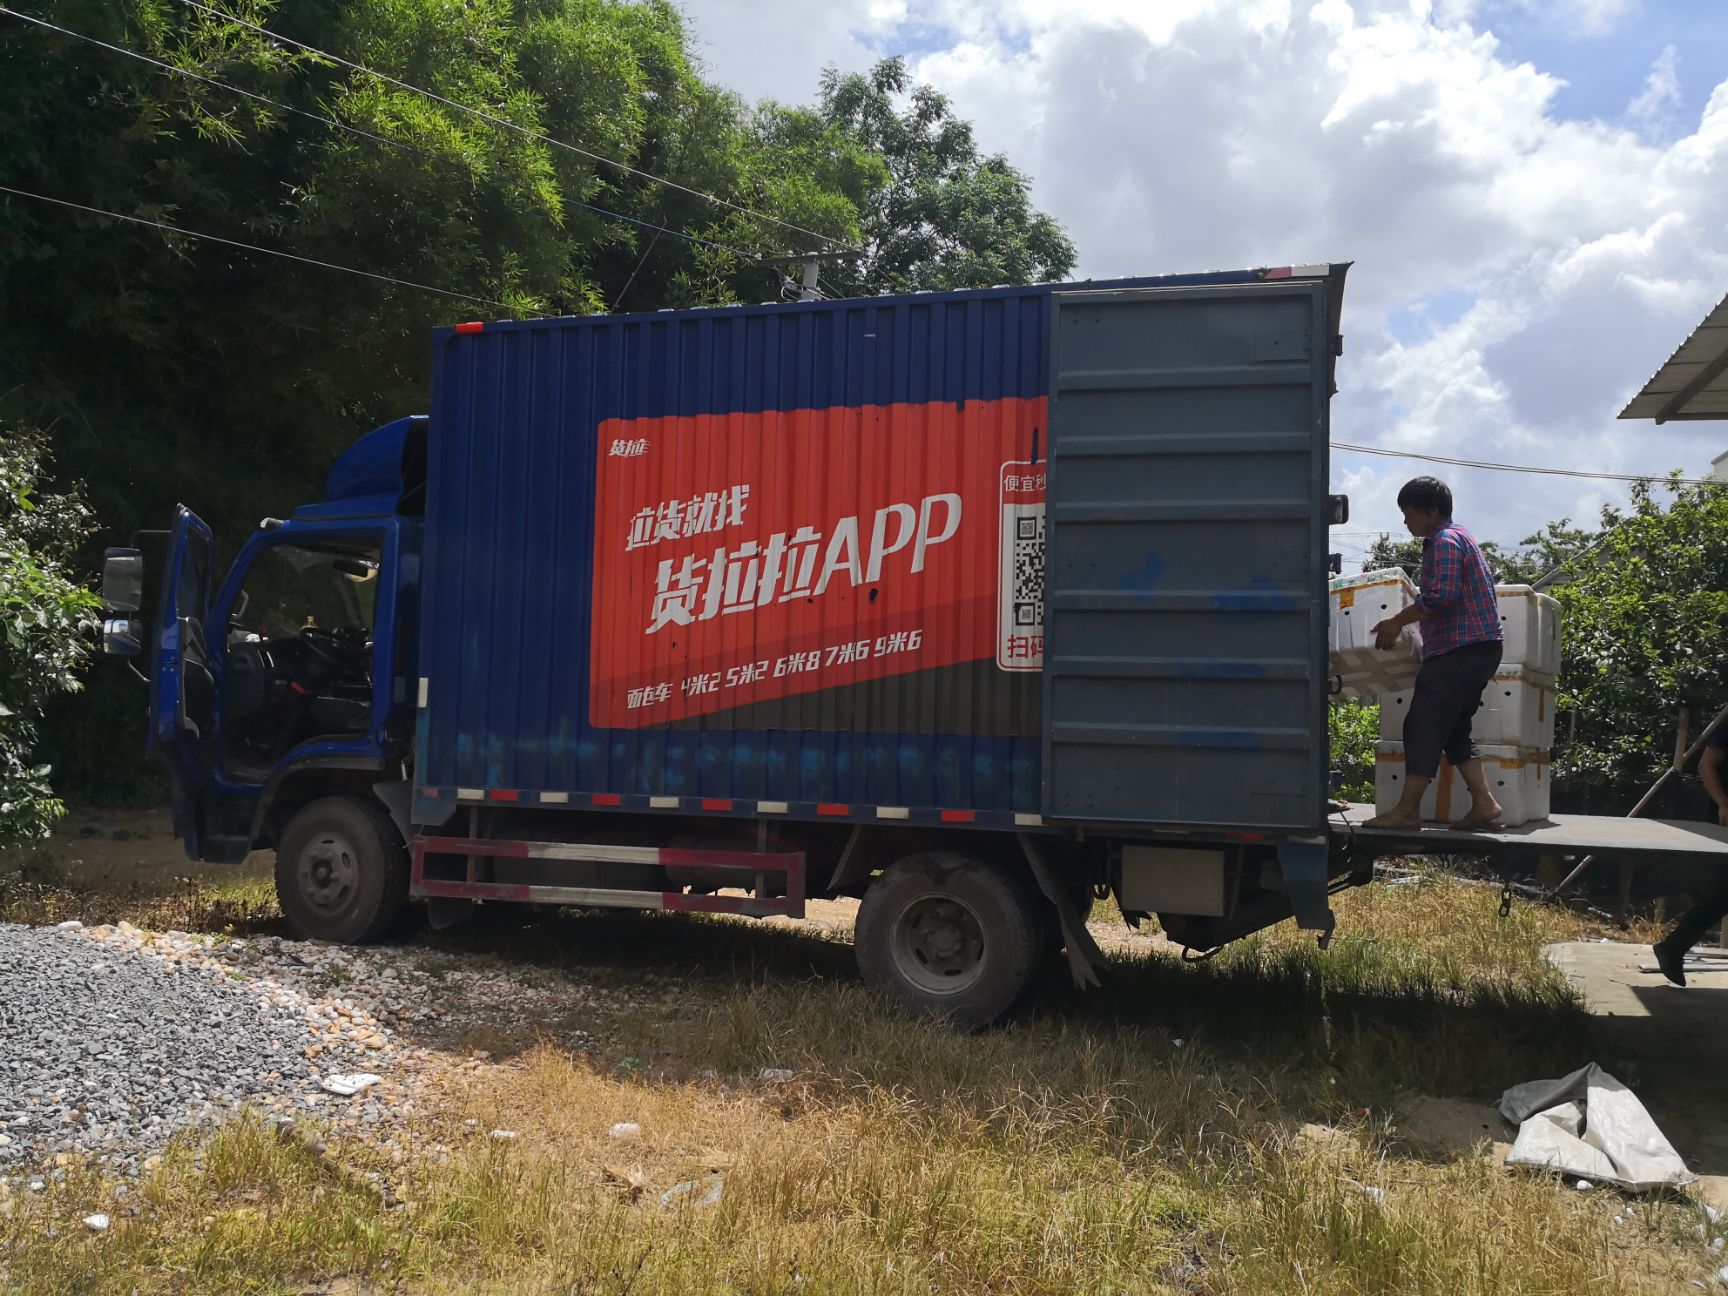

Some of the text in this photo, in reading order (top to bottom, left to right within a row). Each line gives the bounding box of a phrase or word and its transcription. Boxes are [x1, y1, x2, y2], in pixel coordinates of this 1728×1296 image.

[625, 484, 750, 552] 拉货就找
[627, 629, 923, 709] 面包车 4米2 5米2 6米8 7米6 9米6
[1007, 634, 1044, 659] 扫码
